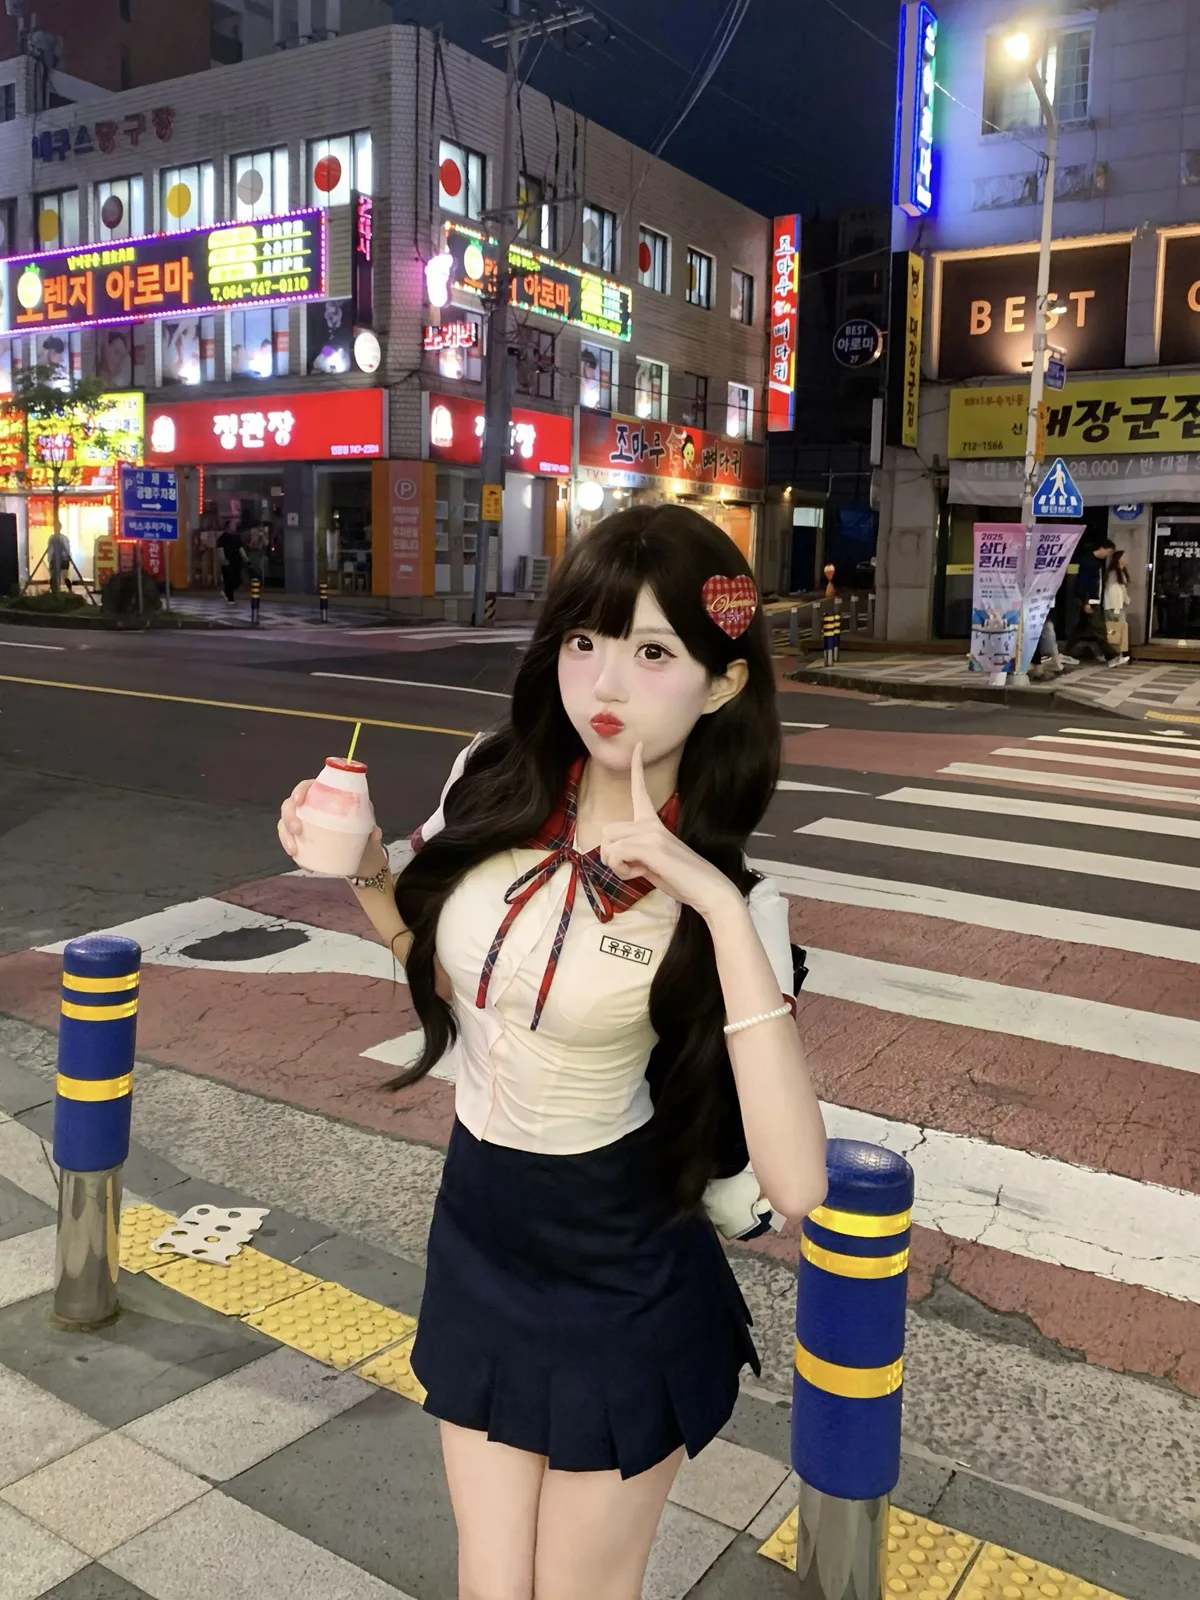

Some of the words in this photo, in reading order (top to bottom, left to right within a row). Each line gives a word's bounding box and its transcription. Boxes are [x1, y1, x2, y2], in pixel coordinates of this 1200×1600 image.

[775, 235, 796, 297] 조마루
[16, 265, 95, 323] 오렌지
[105, 256, 194, 312] 아로마
[210, 276, 309, 302] T.064-747-0110
[524, 273, 571, 316] 아로마
[969, 290, 1096, 336] BEST
[837, 336, 875, 352] 아로마
[845, 325, 869, 336] BEST
[773, 318, 790, 382] 뼈다귀
[213, 410, 296, 450] 정관장
[609, 424, 666, 469] 조마루
[702, 440, 744, 481] 뼈다귀
[1041, 504, 1075, 514] 횡단보도
[980, 542, 1007, 555] 삼다
[982, 533, 1004, 541] 2025
[1040, 534, 1060, 542] 2025
[148, 542, 160, 574] 관장
[979, 556, 1018, 569] 콘서트
